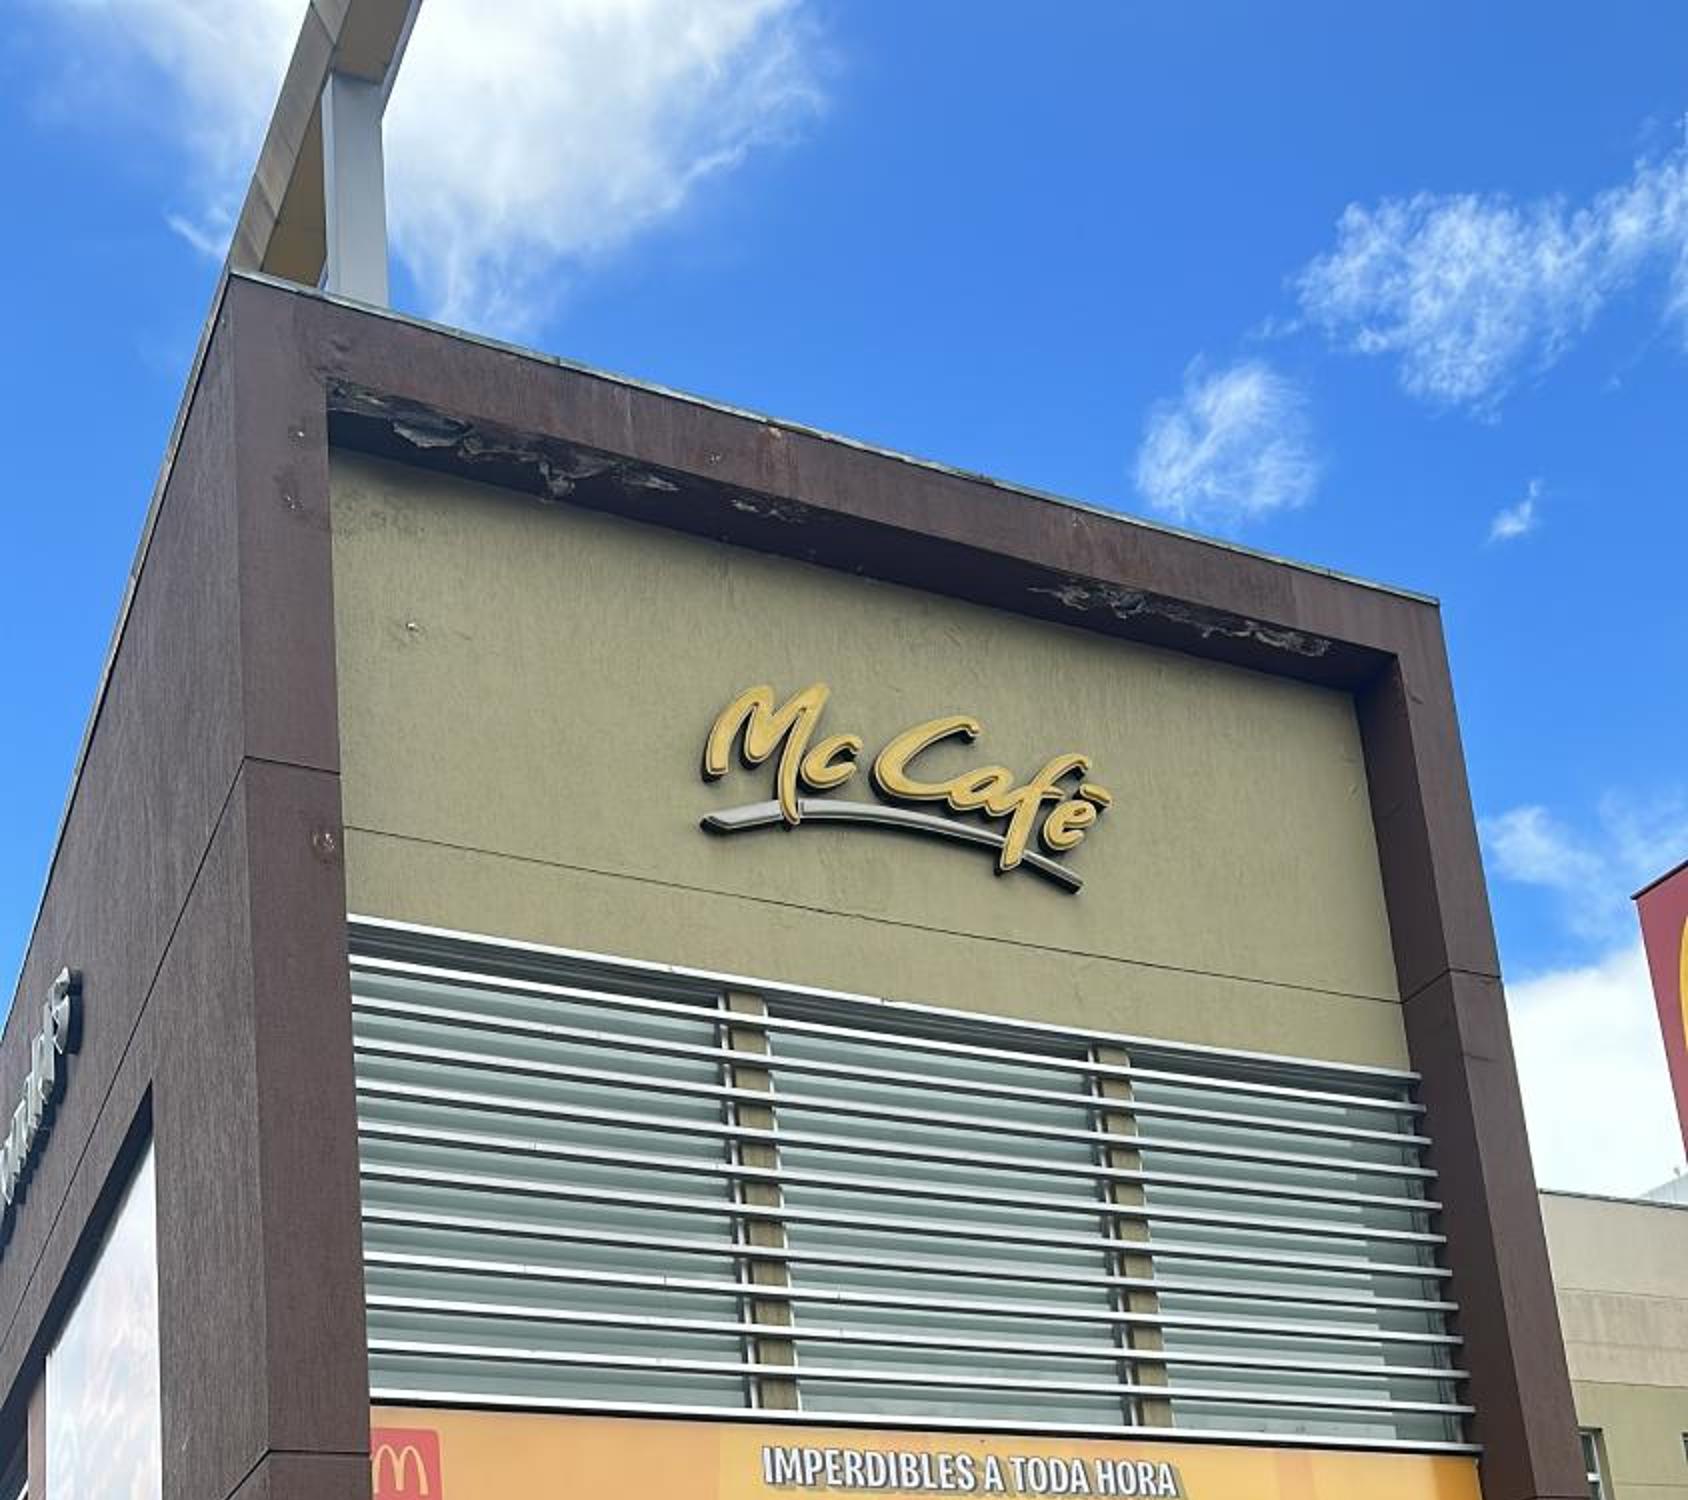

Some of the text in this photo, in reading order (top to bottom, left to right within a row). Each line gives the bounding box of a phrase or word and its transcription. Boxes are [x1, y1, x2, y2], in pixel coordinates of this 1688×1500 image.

[762, 1446, 1179, 1498] IMPERDIBLES A TODA HORA
